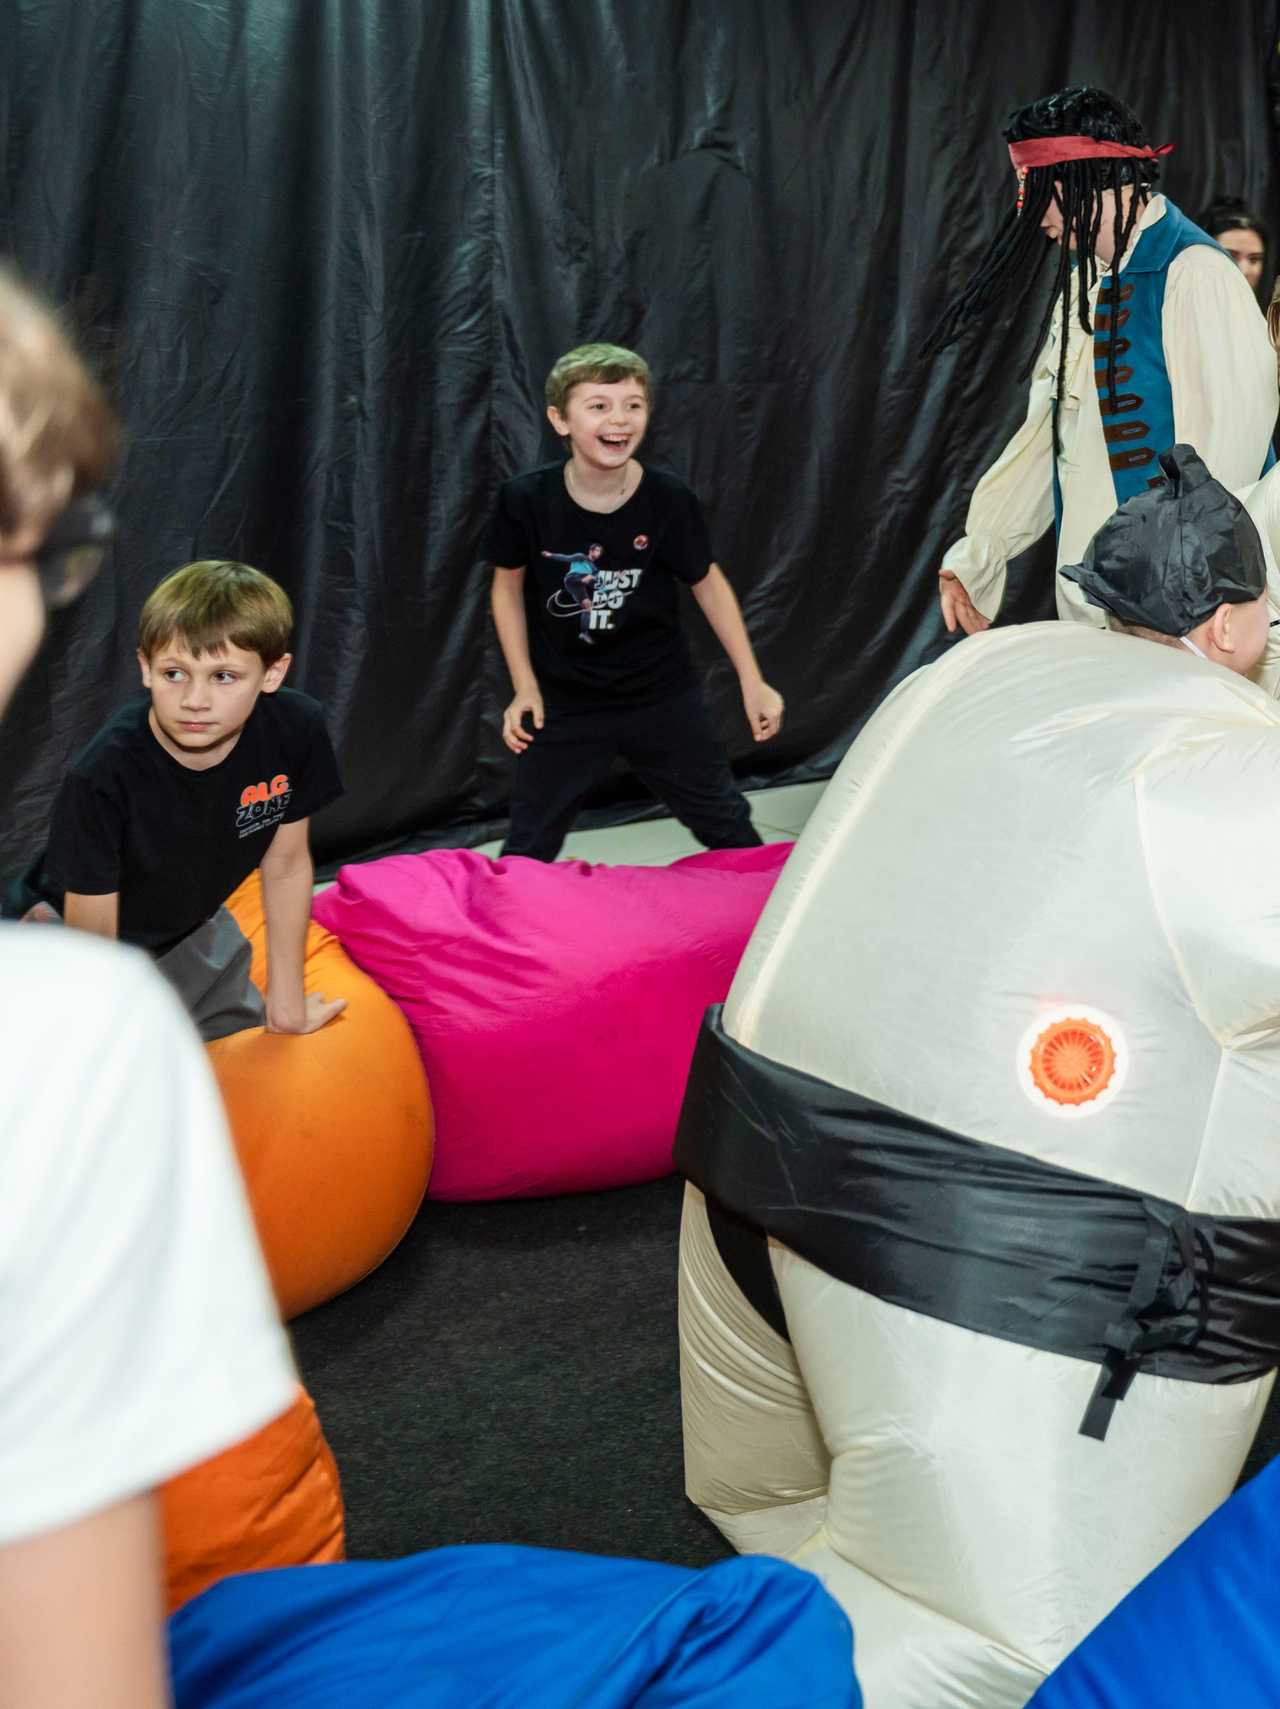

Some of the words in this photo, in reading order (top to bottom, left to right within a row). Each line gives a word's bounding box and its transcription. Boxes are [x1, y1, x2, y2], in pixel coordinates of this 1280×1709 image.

[594, 569, 643, 589] JUST
[591, 590, 625, 609] DO
[588, 609, 614, 629] IT.
[240, 774, 289, 807] ALG
[236, 789, 293, 827] ZONE
